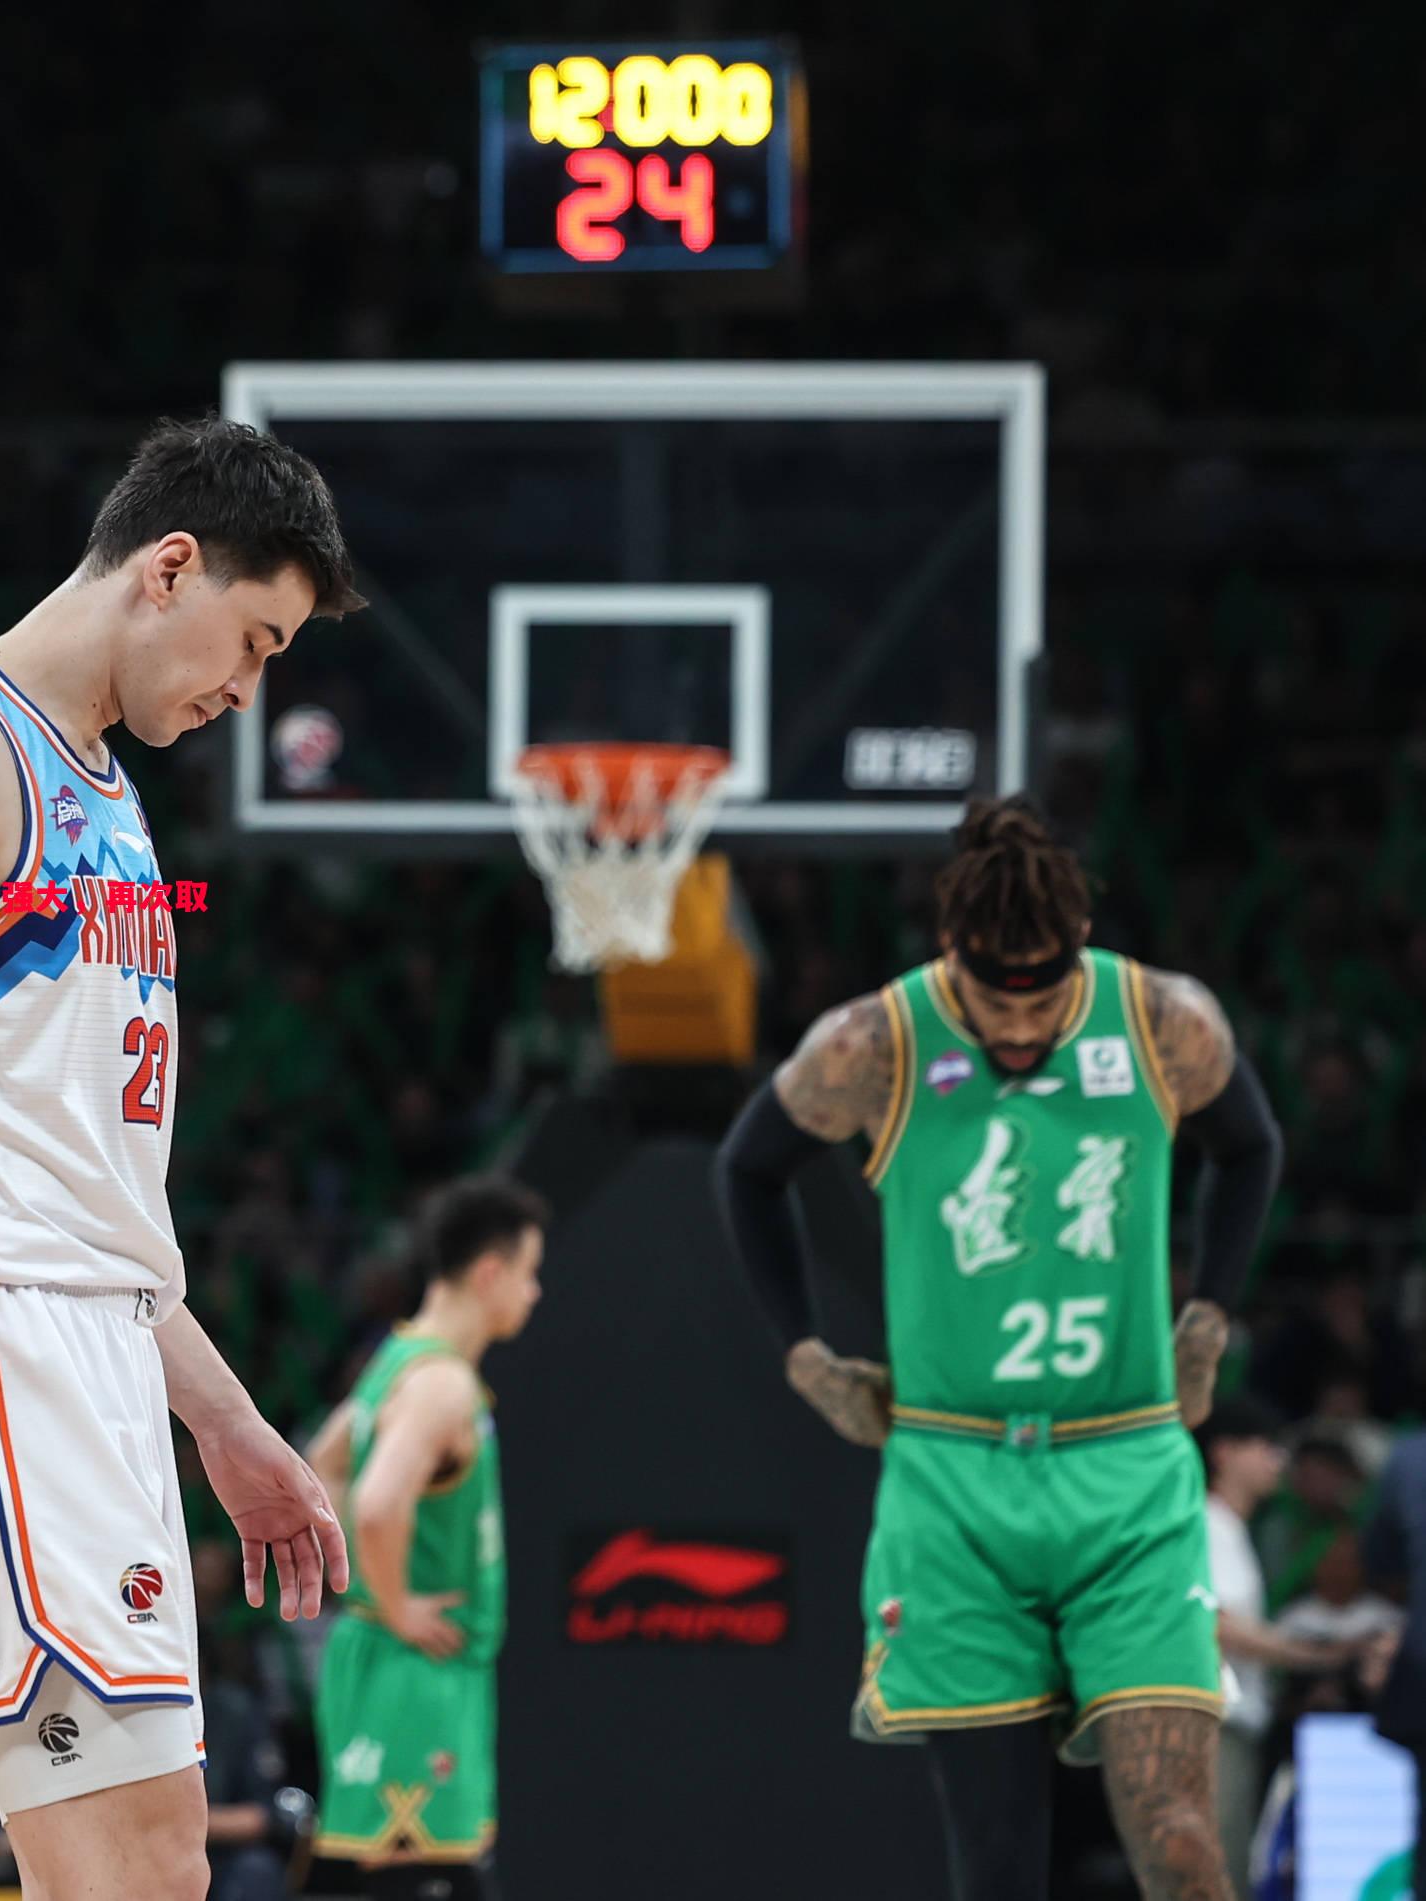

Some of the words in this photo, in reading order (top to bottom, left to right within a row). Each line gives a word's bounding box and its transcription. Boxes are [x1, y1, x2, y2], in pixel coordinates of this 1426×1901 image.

[556, 148, 714, 261] 24
[123, 1016, 169, 1131] 23
[993, 1297, 1108, 1380] 25
[127, 1612, 158, 1624] CBA
[51, 1752, 82, 1767] CBA
